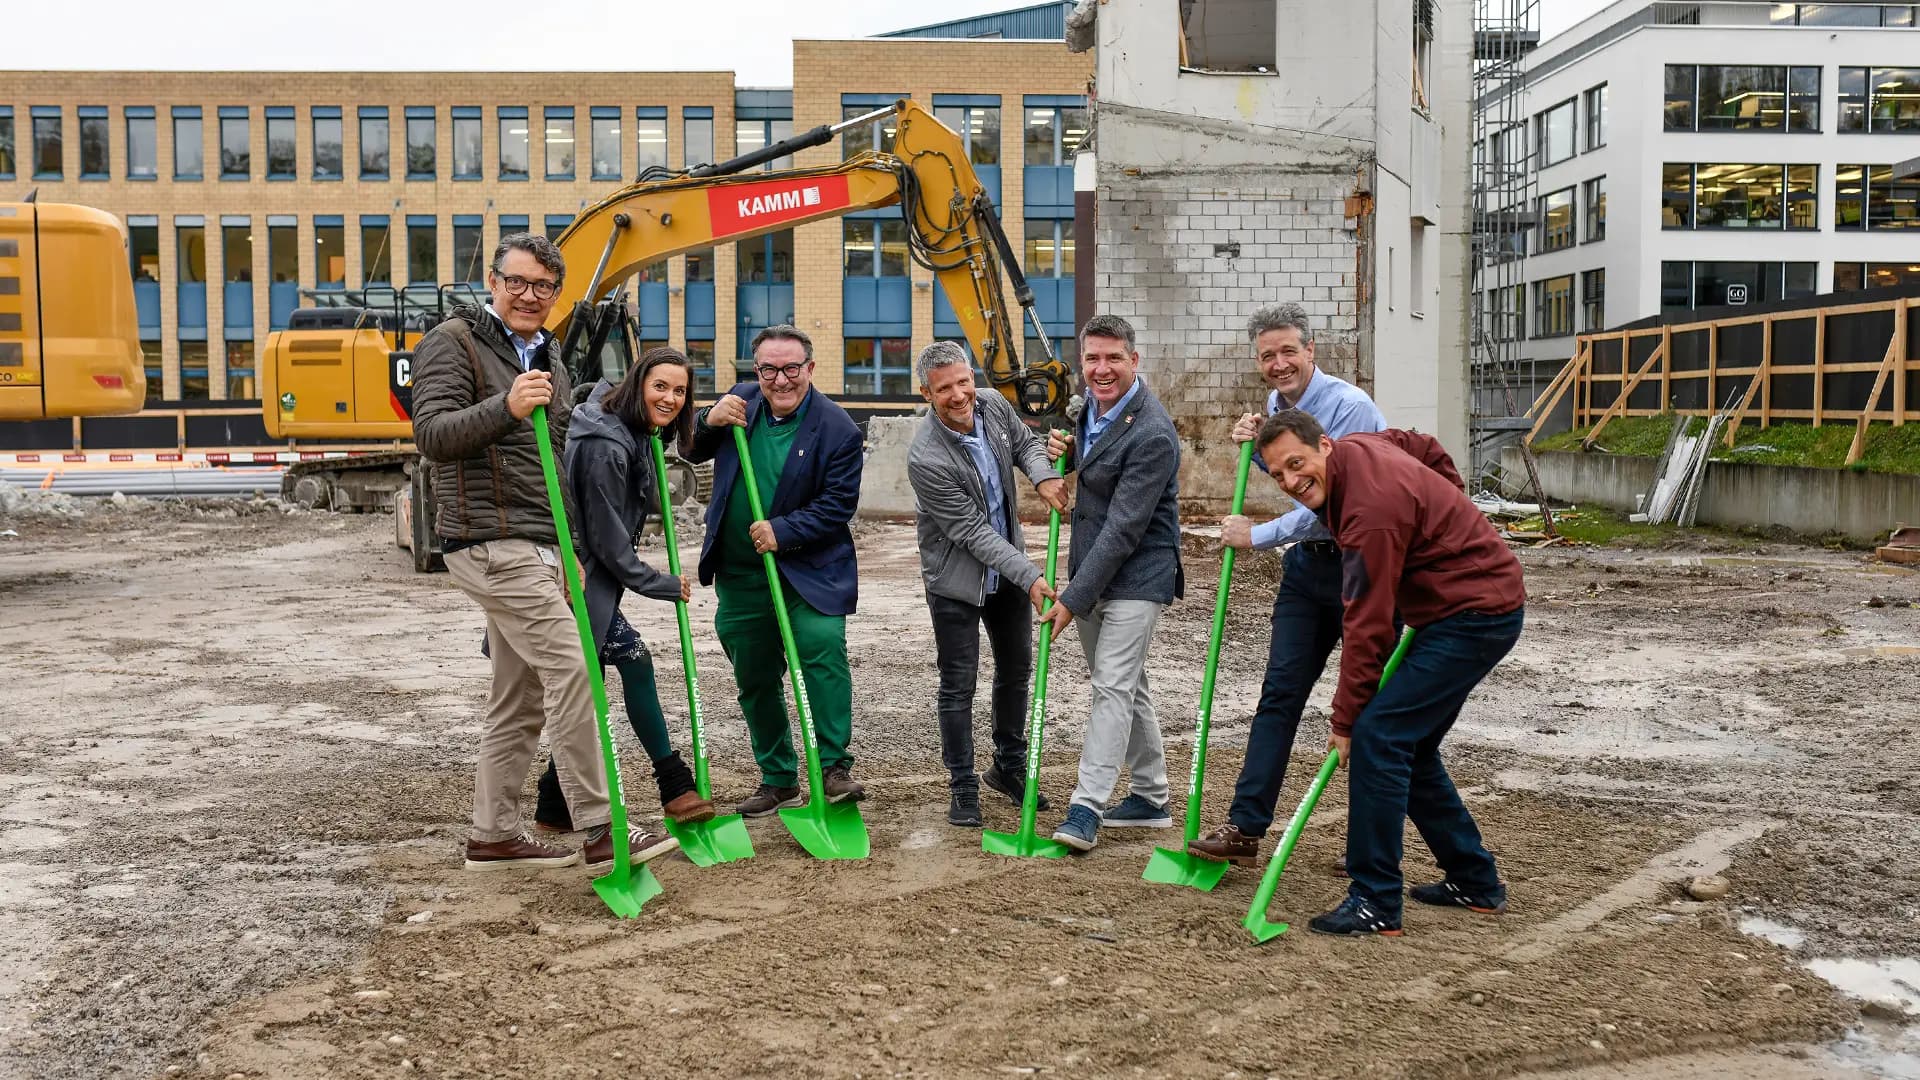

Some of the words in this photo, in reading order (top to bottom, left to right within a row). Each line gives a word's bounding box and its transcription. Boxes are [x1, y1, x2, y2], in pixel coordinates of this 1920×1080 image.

[738, 190, 800, 217] KAMM
[1730, 289, 1744, 297] GO
[691, 677, 708, 759] SENSIRION
[793, 669, 818, 750] SENSIRION
[1028, 698, 1044, 780] SENSIRION
[1188, 709, 1206, 797] SENSIRION
